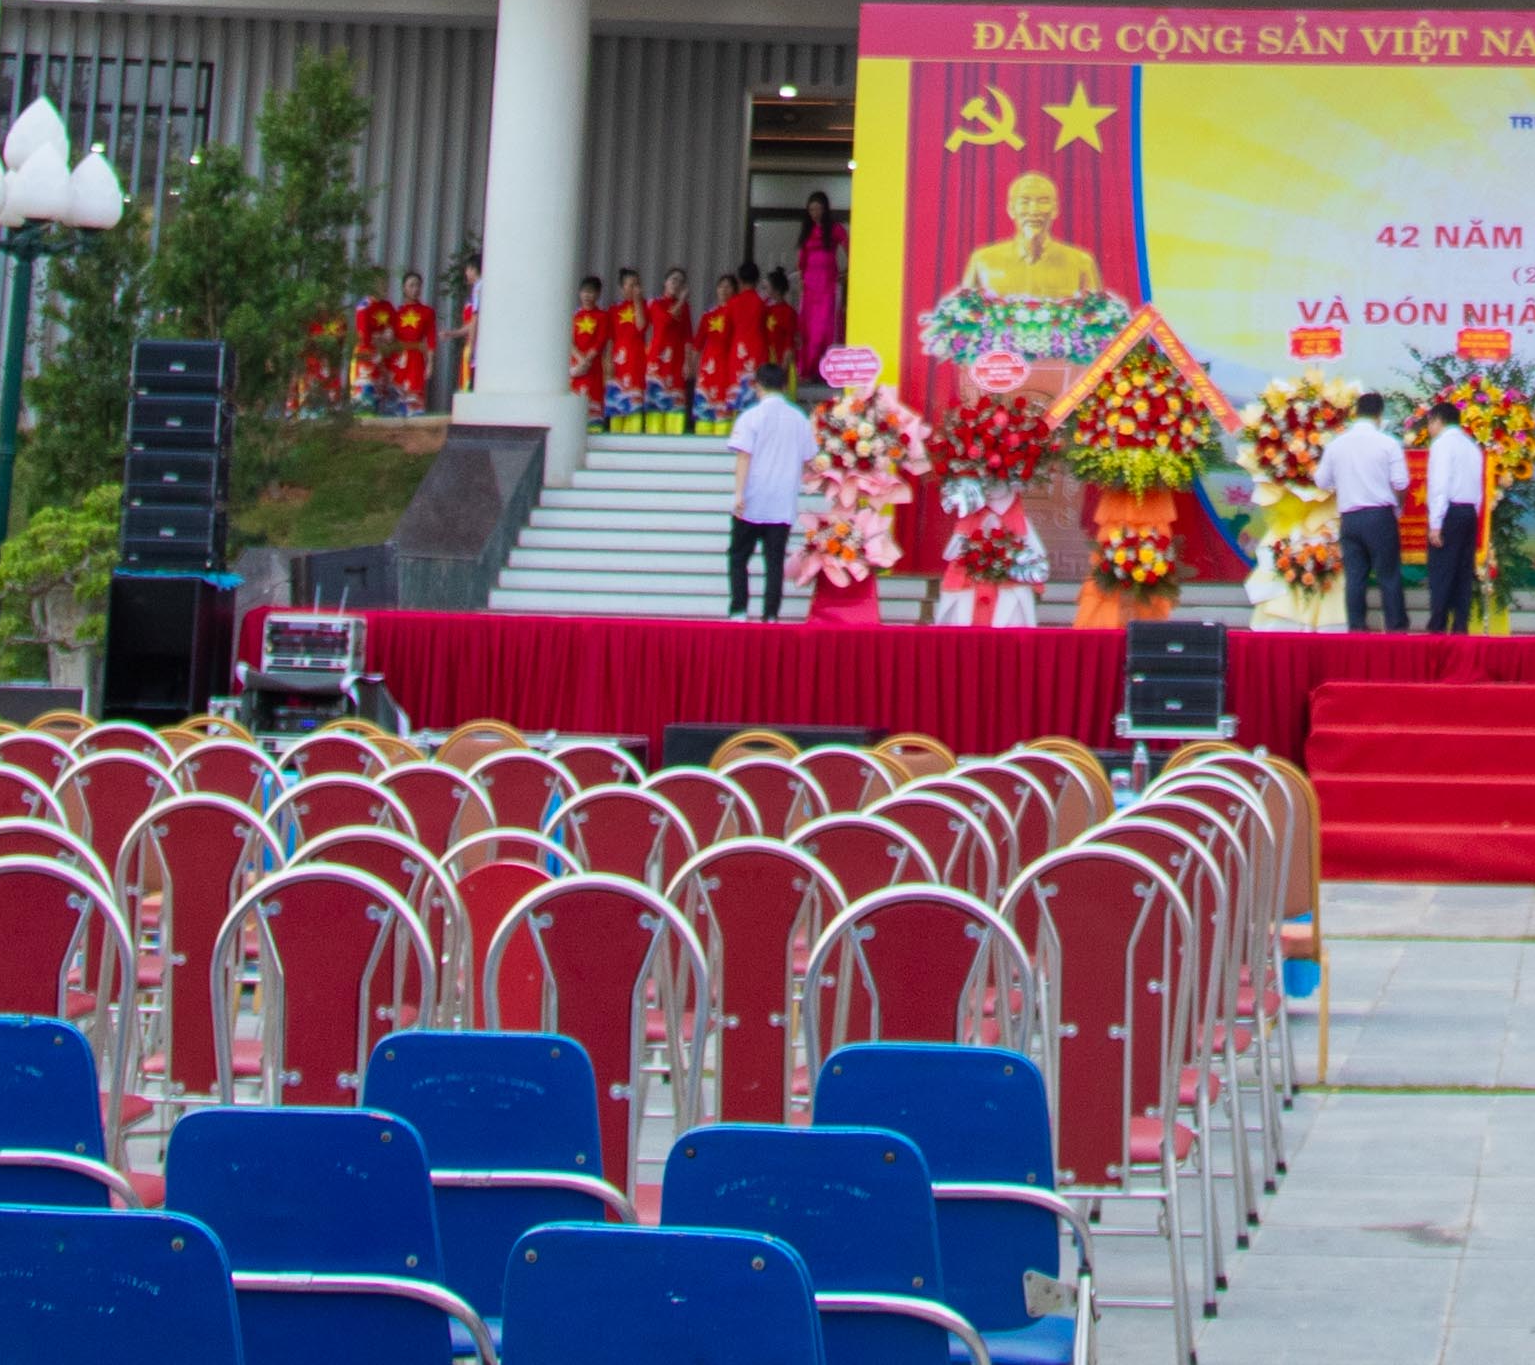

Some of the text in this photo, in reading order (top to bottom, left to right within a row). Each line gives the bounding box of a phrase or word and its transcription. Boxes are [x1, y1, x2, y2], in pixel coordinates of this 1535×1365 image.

[972, 12, 1103, 52] ĐẢNG
[1115, 16, 1247, 61] CỘNG
[1257, 15, 1349, 56] SẢN
[1360, 19, 1468, 63] VIỆT
[1376, 225, 1420, 248] 42
[1435, 219, 1523, 249] NĂM
[1298, 295, 1350, 324] VÀ
[1363, 295, 1448, 325] ĐÓN
